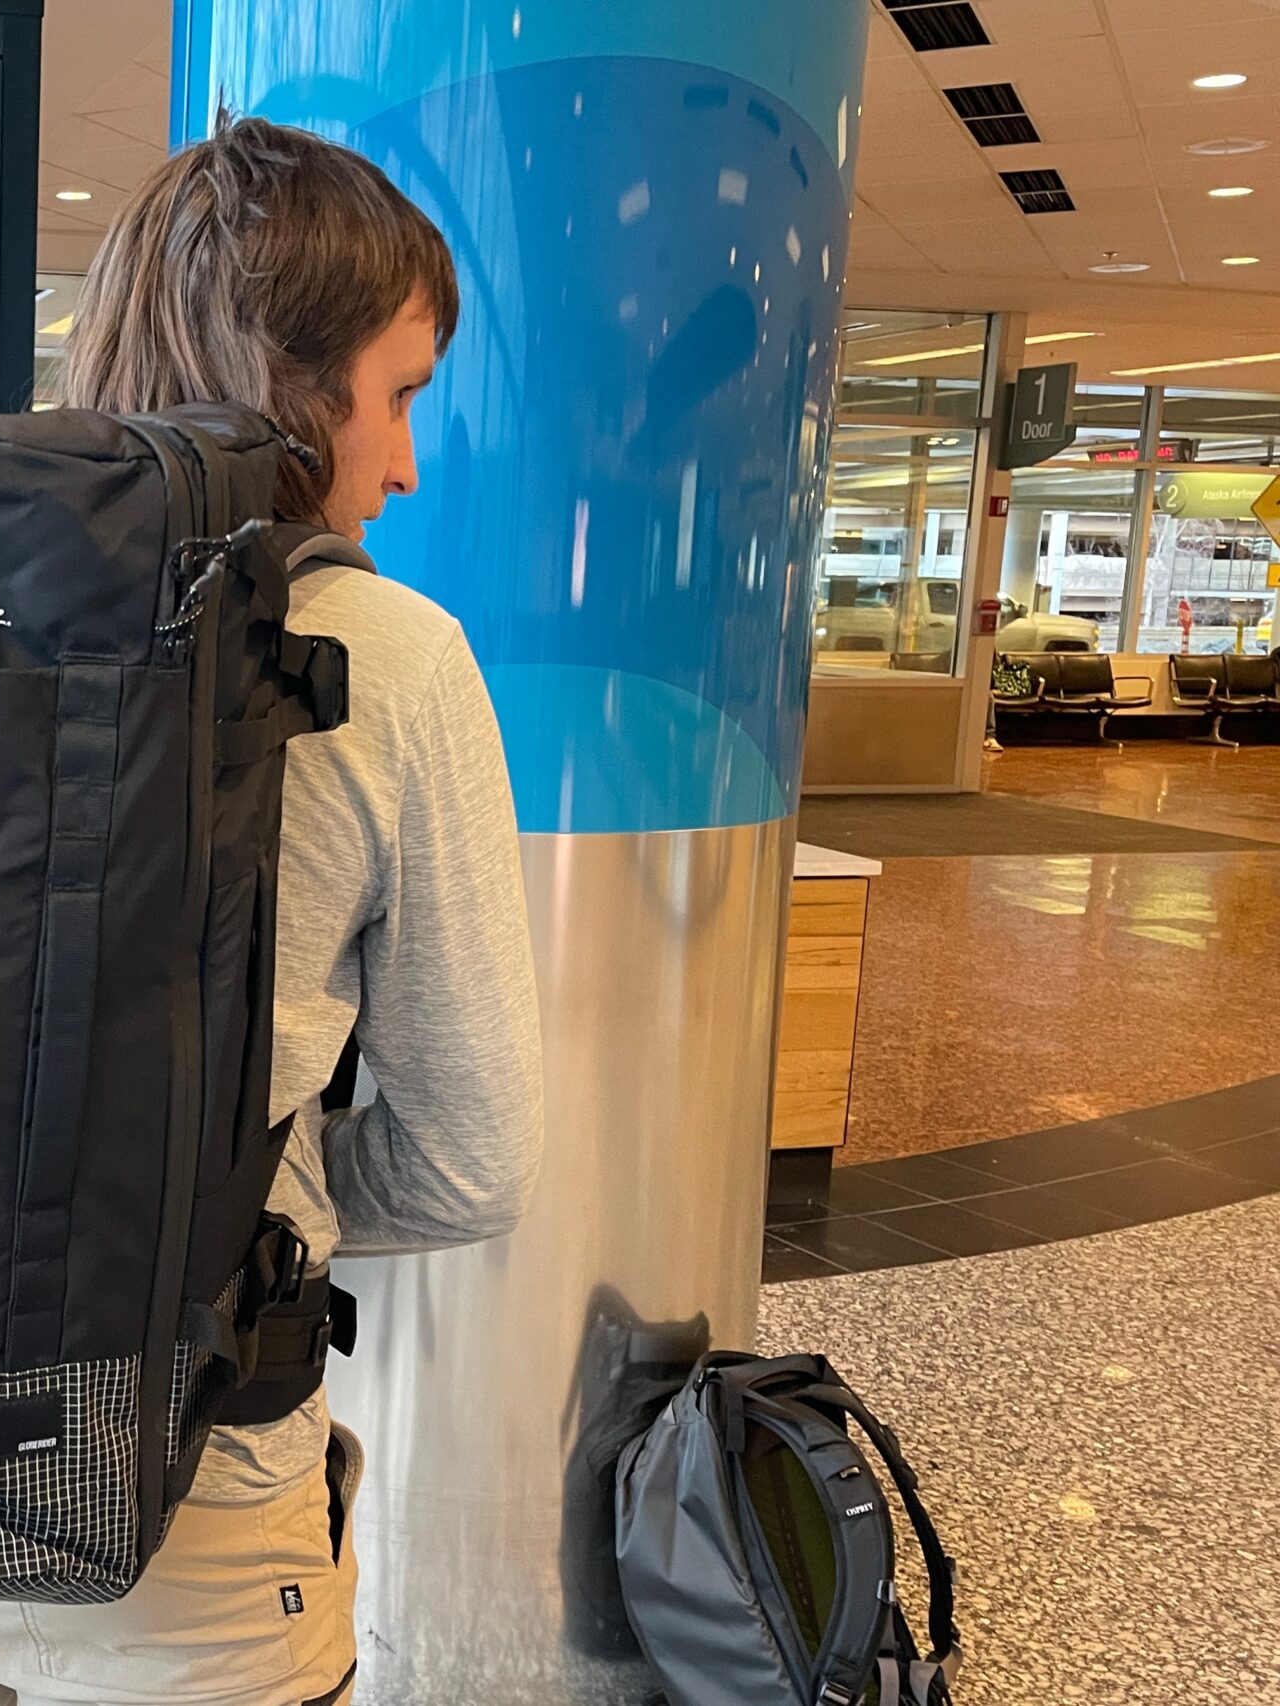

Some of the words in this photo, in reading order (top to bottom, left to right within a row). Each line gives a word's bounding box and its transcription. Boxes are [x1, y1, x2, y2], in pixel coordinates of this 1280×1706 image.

[1034, 373, 1047, 416] 1
[1022, 421, 1053, 439] Door
[1166, 484, 1179, 508] 2
[1202, 488, 1230, 501] Alaska
[845, 1502, 873, 1516] OSPREY
